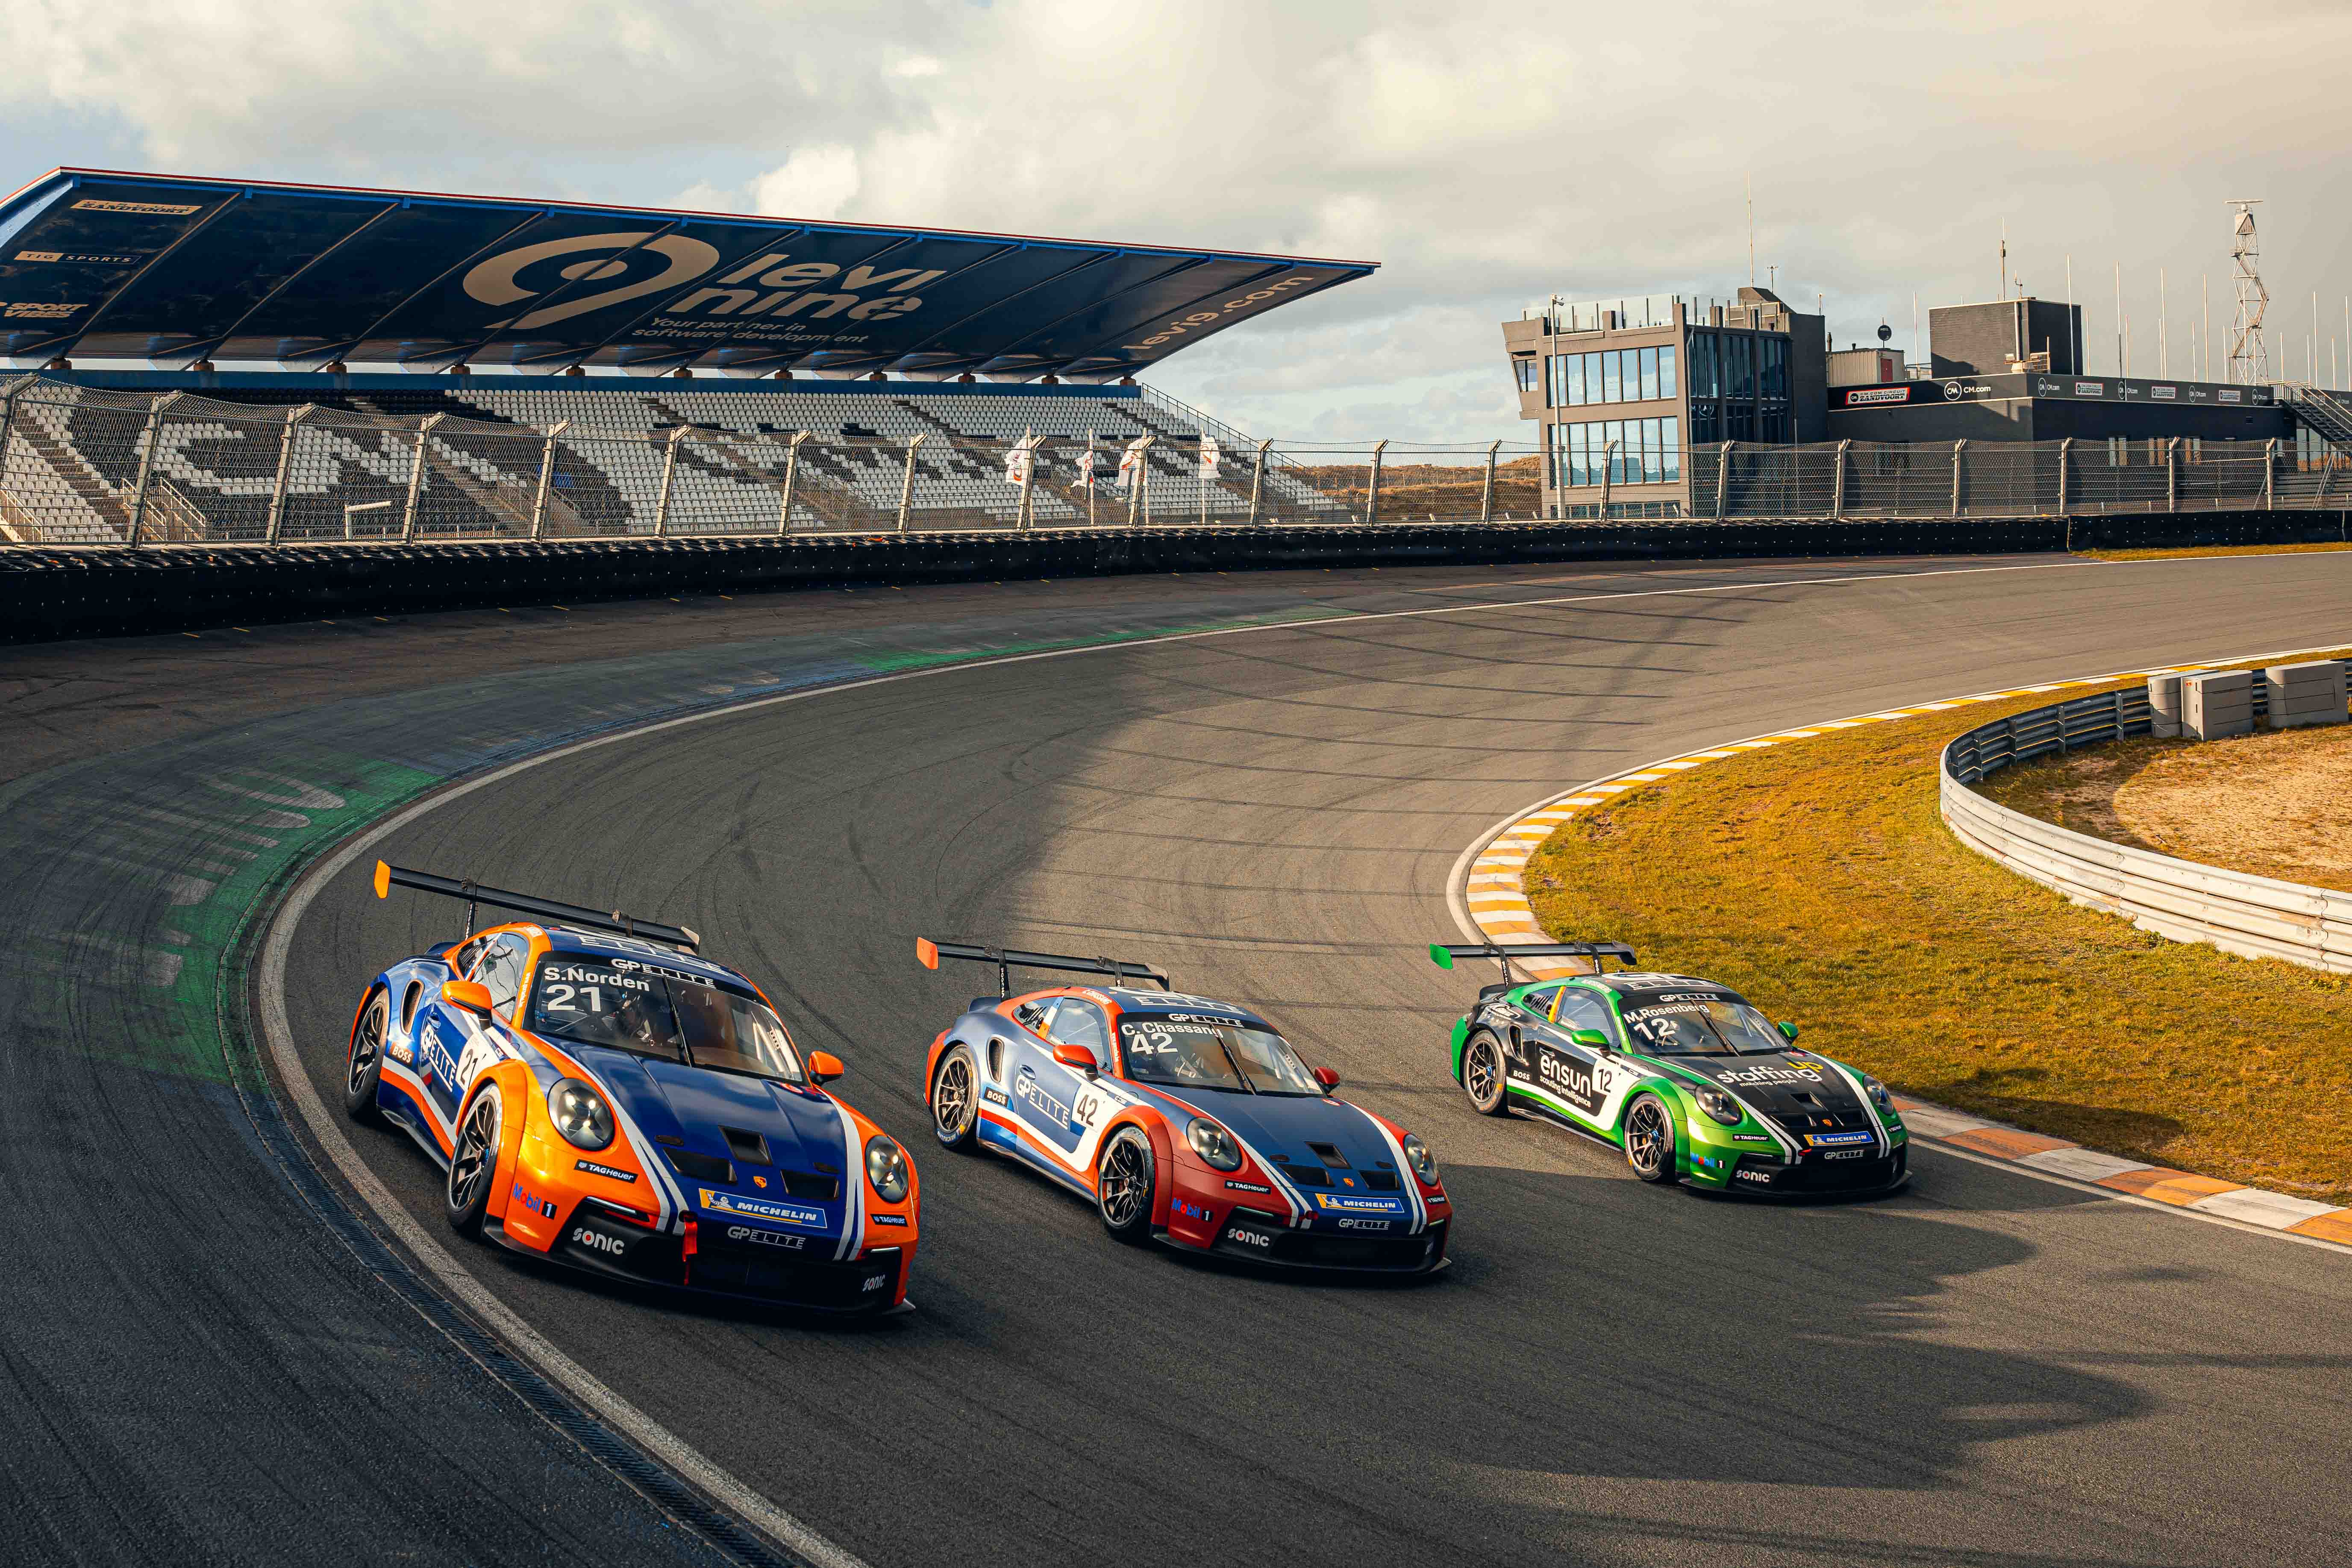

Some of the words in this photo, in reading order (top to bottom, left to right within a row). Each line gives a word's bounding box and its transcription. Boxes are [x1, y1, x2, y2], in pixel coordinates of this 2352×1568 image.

[81, 203, 189, 213] ZANDVOORT
[716, 253, 947, 291] levi
[665, 287, 922, 321] nine
[1121, 277, 1315, 350] levi9.com
[632, 327, 726, 338] software
[735, 330, 869, 343] development
[651, 318, 698, 330] Your
[700, 319, 773, 332] partner
[785, 323, 806, 332] in
[1859, 393, 1905, 402] ZANDVOORT
[544, 967, 650, 991] S.Norden
[1624, 979, 1717, 990] ELITE
[547, 984, 602, 1012] 21
[1623, 1003, 1710, 1024] M.Rosenberg
[1121, 1024, 1140, 1036] C.
[1141, 1022, 1223, 1038] Chassang
[1633, 1018, 1676, 1040] 12
[1131, 1033, 1178, 1055] 42
[391, 1046, 412, 1064] BOSS
[460, 1048, 479, 1091] 21
[1513, 1070, 1530, 1081] BOSS
[1541, 1054, 1591, 1098] ensun
[1717, 1066, 1823, 1083] staffing
[1786, 1061, 1824, 1073] up
[1598, 1068, 1612, 1093] 12
[986, 1090, 1007, 1105] BOSS
[1540, 1075, 1561, 1094] scouting
[1561, 1085, 1591, 1108] intelligence
[1077, 1094, 1098, 1127] 42
[1690, 1152, 1715, 1168] Mobil
[1718, 1160, 1723, 1169] 1
[512, 1183, 541, 1213] Mobil
[545, 1203, 552, 1217] 1
[1171, 1197, 1200, 1218] Mobil
[1205, 1210, 1210, 1221] 1
[1344, 1200, 1396, 1209] MICHELIN
[737, 1202, 817, 1221] MICHELIN
